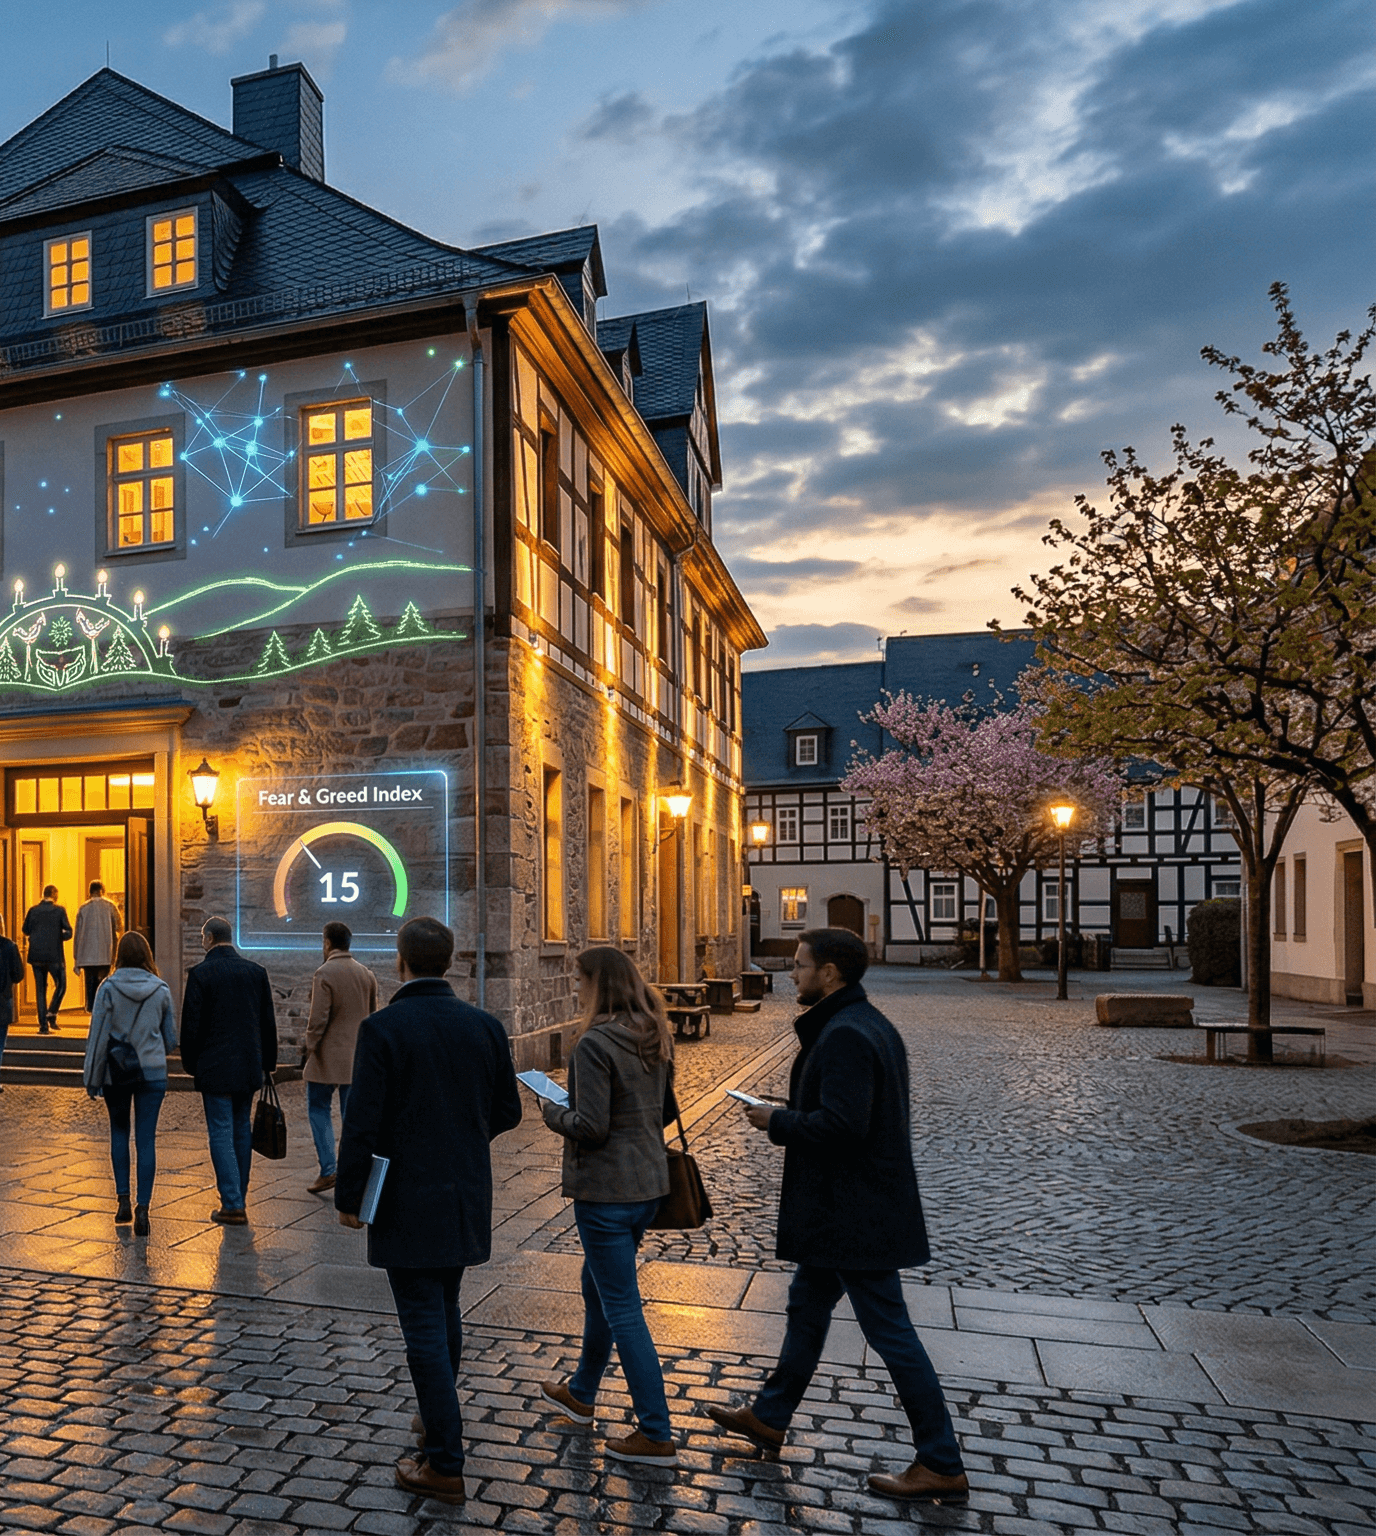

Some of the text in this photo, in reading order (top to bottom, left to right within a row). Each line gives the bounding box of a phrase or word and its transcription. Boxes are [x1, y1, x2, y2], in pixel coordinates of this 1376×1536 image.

[258, 785, 423, 806] Fear & Greed Index
[319, 872, 360, 903] 15
